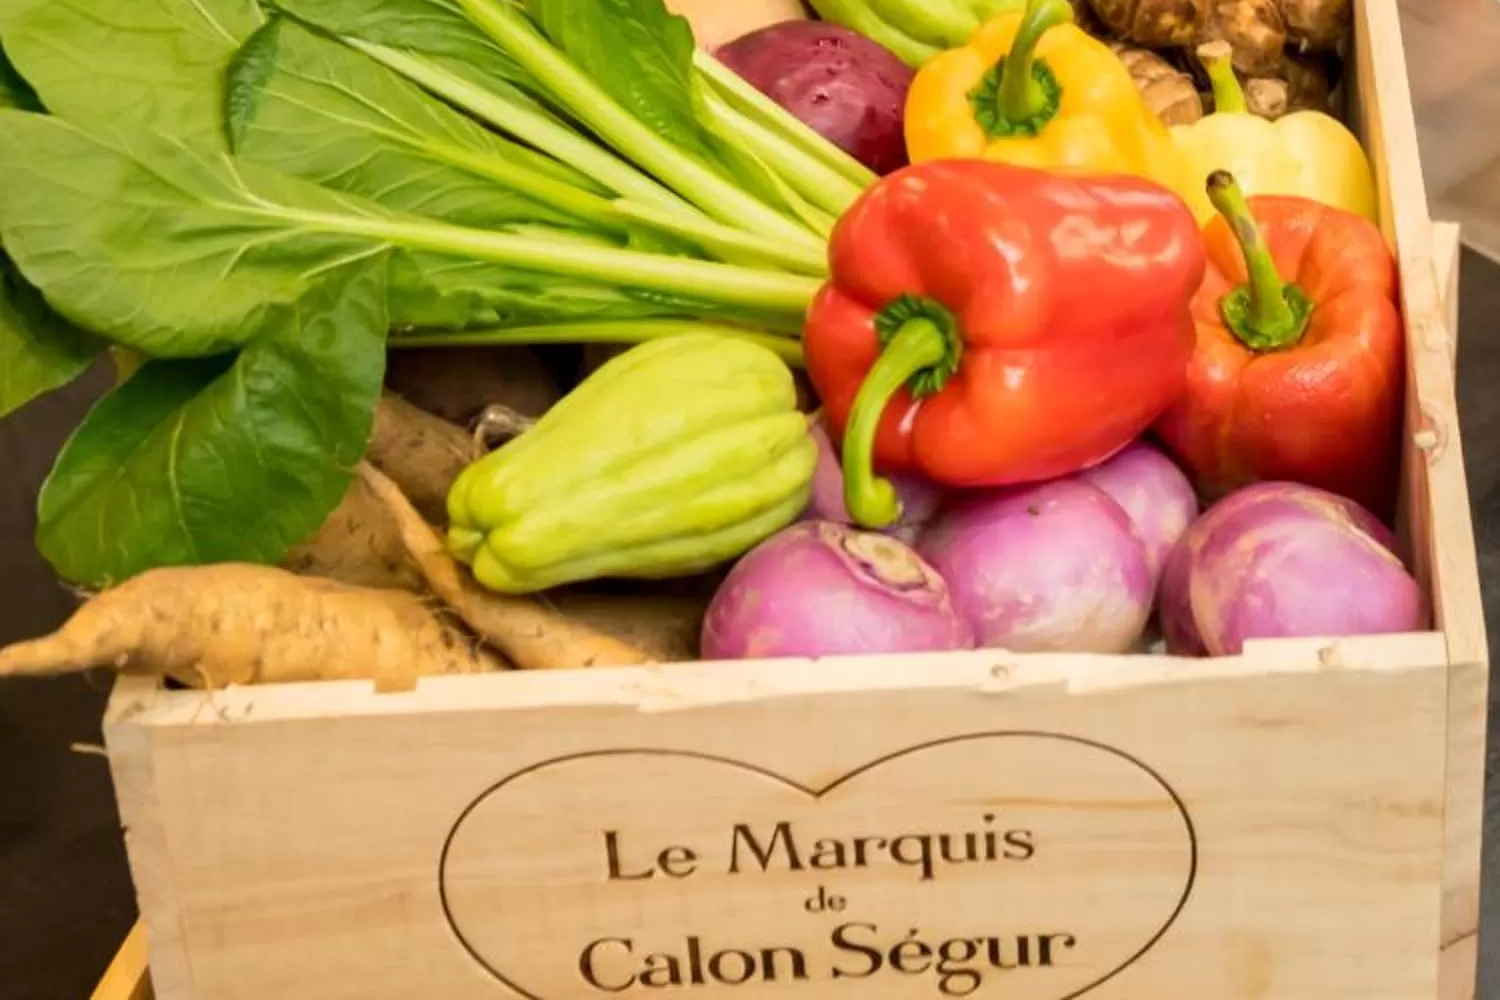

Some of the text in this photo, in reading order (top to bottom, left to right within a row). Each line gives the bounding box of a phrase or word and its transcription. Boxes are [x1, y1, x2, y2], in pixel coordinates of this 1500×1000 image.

[603, 813, 1036, 881] Le Marquis
[803, 885, 848, 913] de
[578, 921, 1077, 998] Calon Ségur
